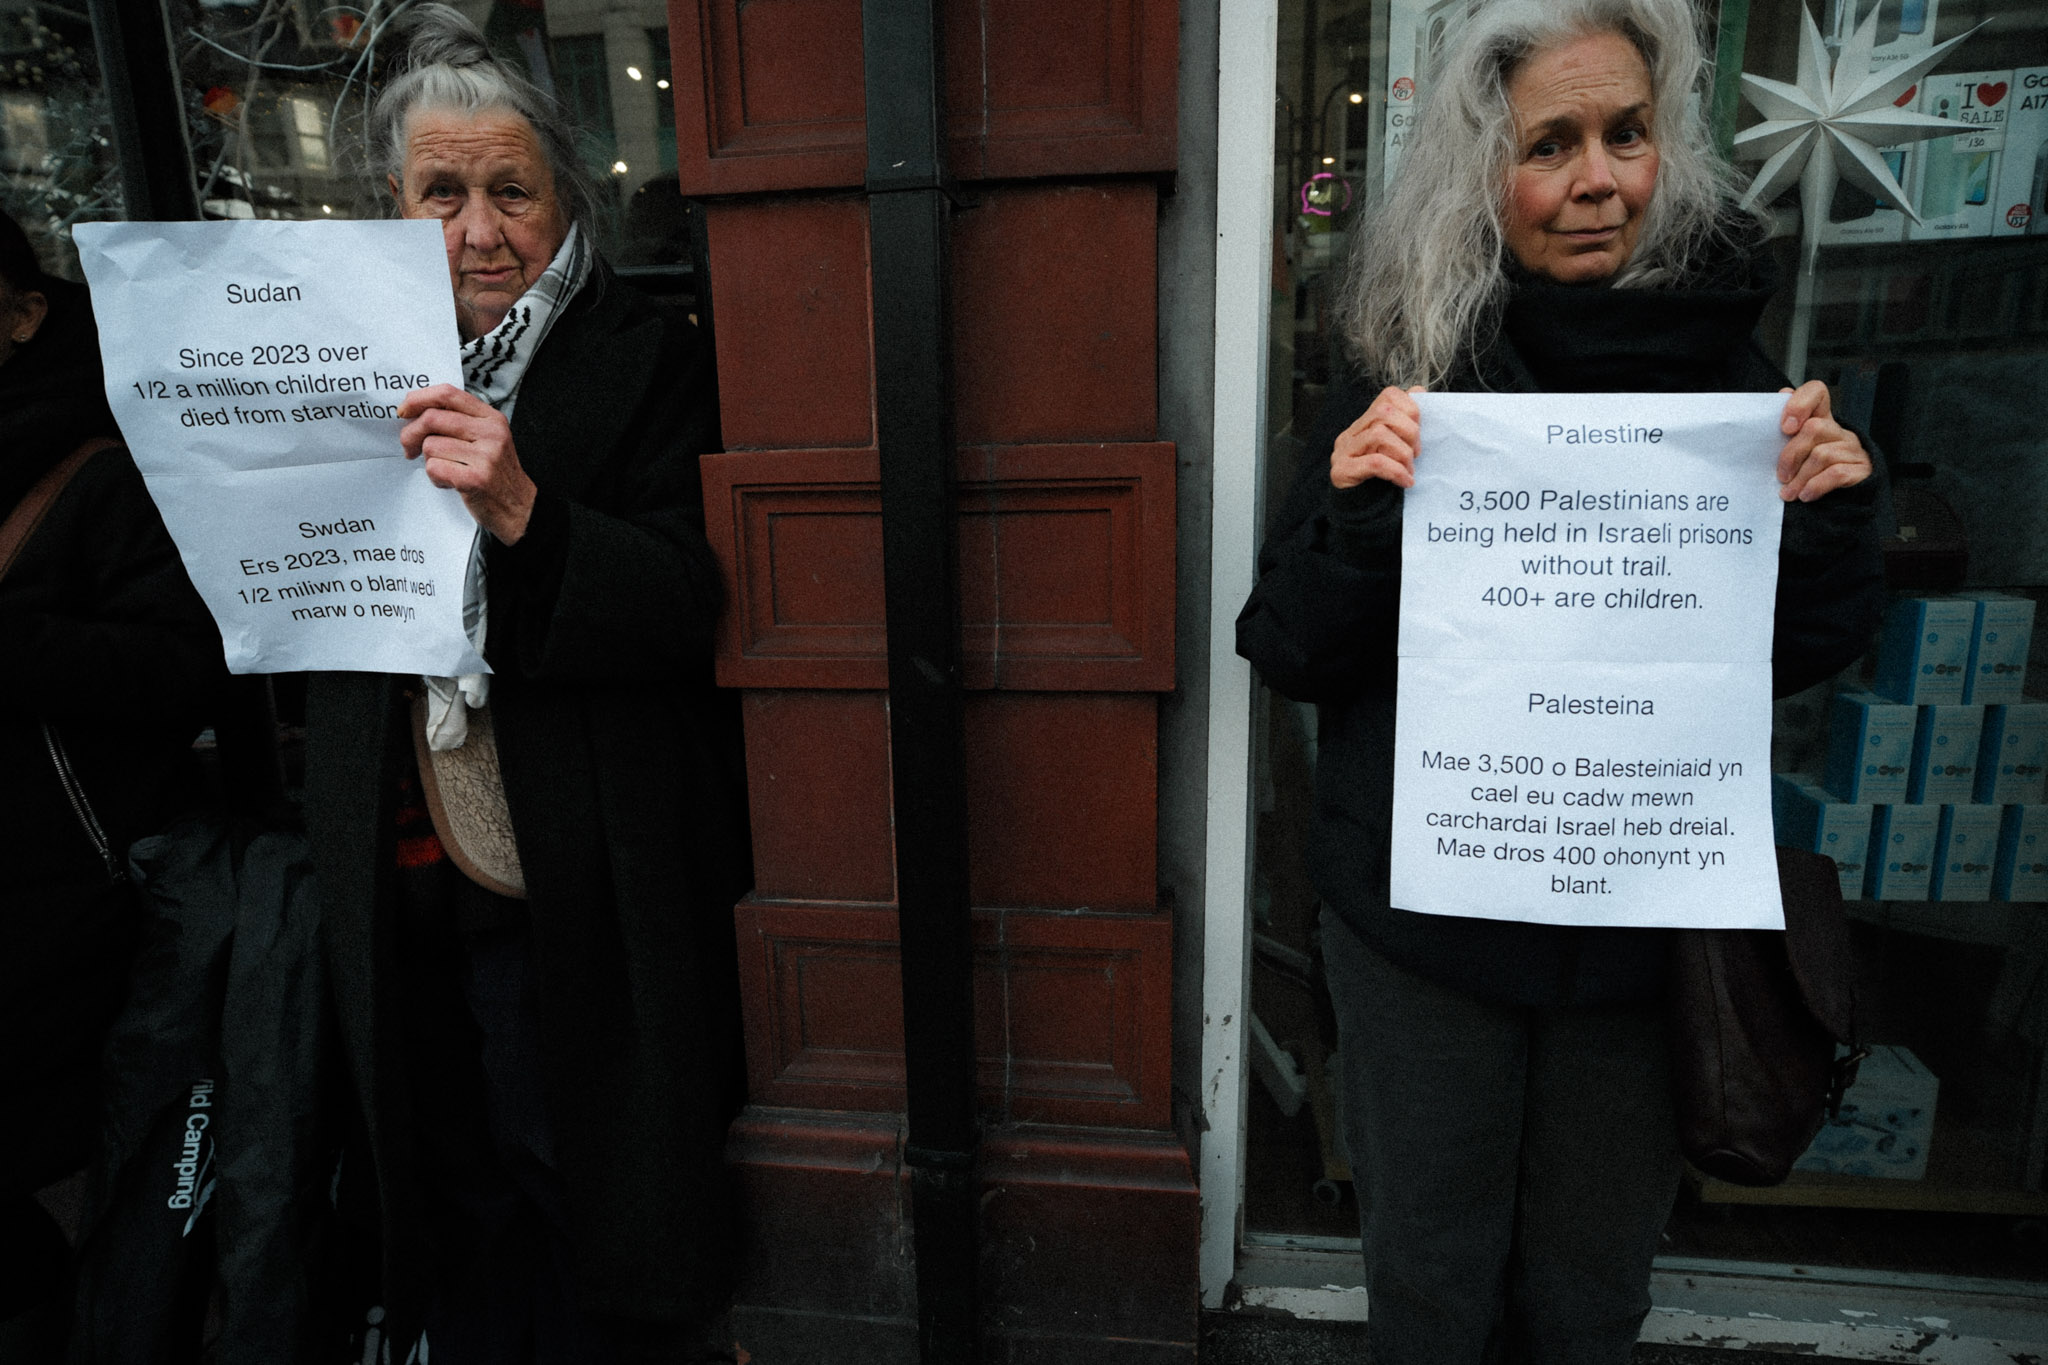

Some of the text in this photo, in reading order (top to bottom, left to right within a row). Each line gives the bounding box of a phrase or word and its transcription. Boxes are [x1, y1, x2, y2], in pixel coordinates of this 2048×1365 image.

[1960, 110, 2004, 124] SALE
[226, 282, 302, 305] Sudan
[179, 343, 369, 369] Since 2023 over
[132, 370, 430, 400] 1/2 a million children have
[180, 406, 231, 428] died
[233, 405, 287, 425] from
[1547, 423, 1664, 445] Palestine
[1459, 489, 1729, 513] 3,500 Palestinians are
[298, 517, 376, 539] Swdan
[1428, 522, 1753, 549] being held in Israeli prisons
[239, 544, 425, 576] Ers 2023, mae dros
[1521, 554, 1671, 577] without trail.
[237, 574, 435, 605] 1/2 miliwn o blant wedi
[1481, 586, 1703, 610] 400+ are children.
[291, 604, 416, 622] marw o newyn
[1528, 692, 1655, 716] Palesteina
[1422, 750, 1743, 782] Mae 3,500 o Balesteiniaid yn
[1470, 784, 1694, 807] cael eu cadw mewn
[1426, 811, 1735, 837] carchardai Israel heb dreial.
[1437, 837, 1725, 871] Mae dros 400 ohonynt yn
[1551, 874, 1612, 895] blant.
[167, 1113, 210, 1210] Camping
